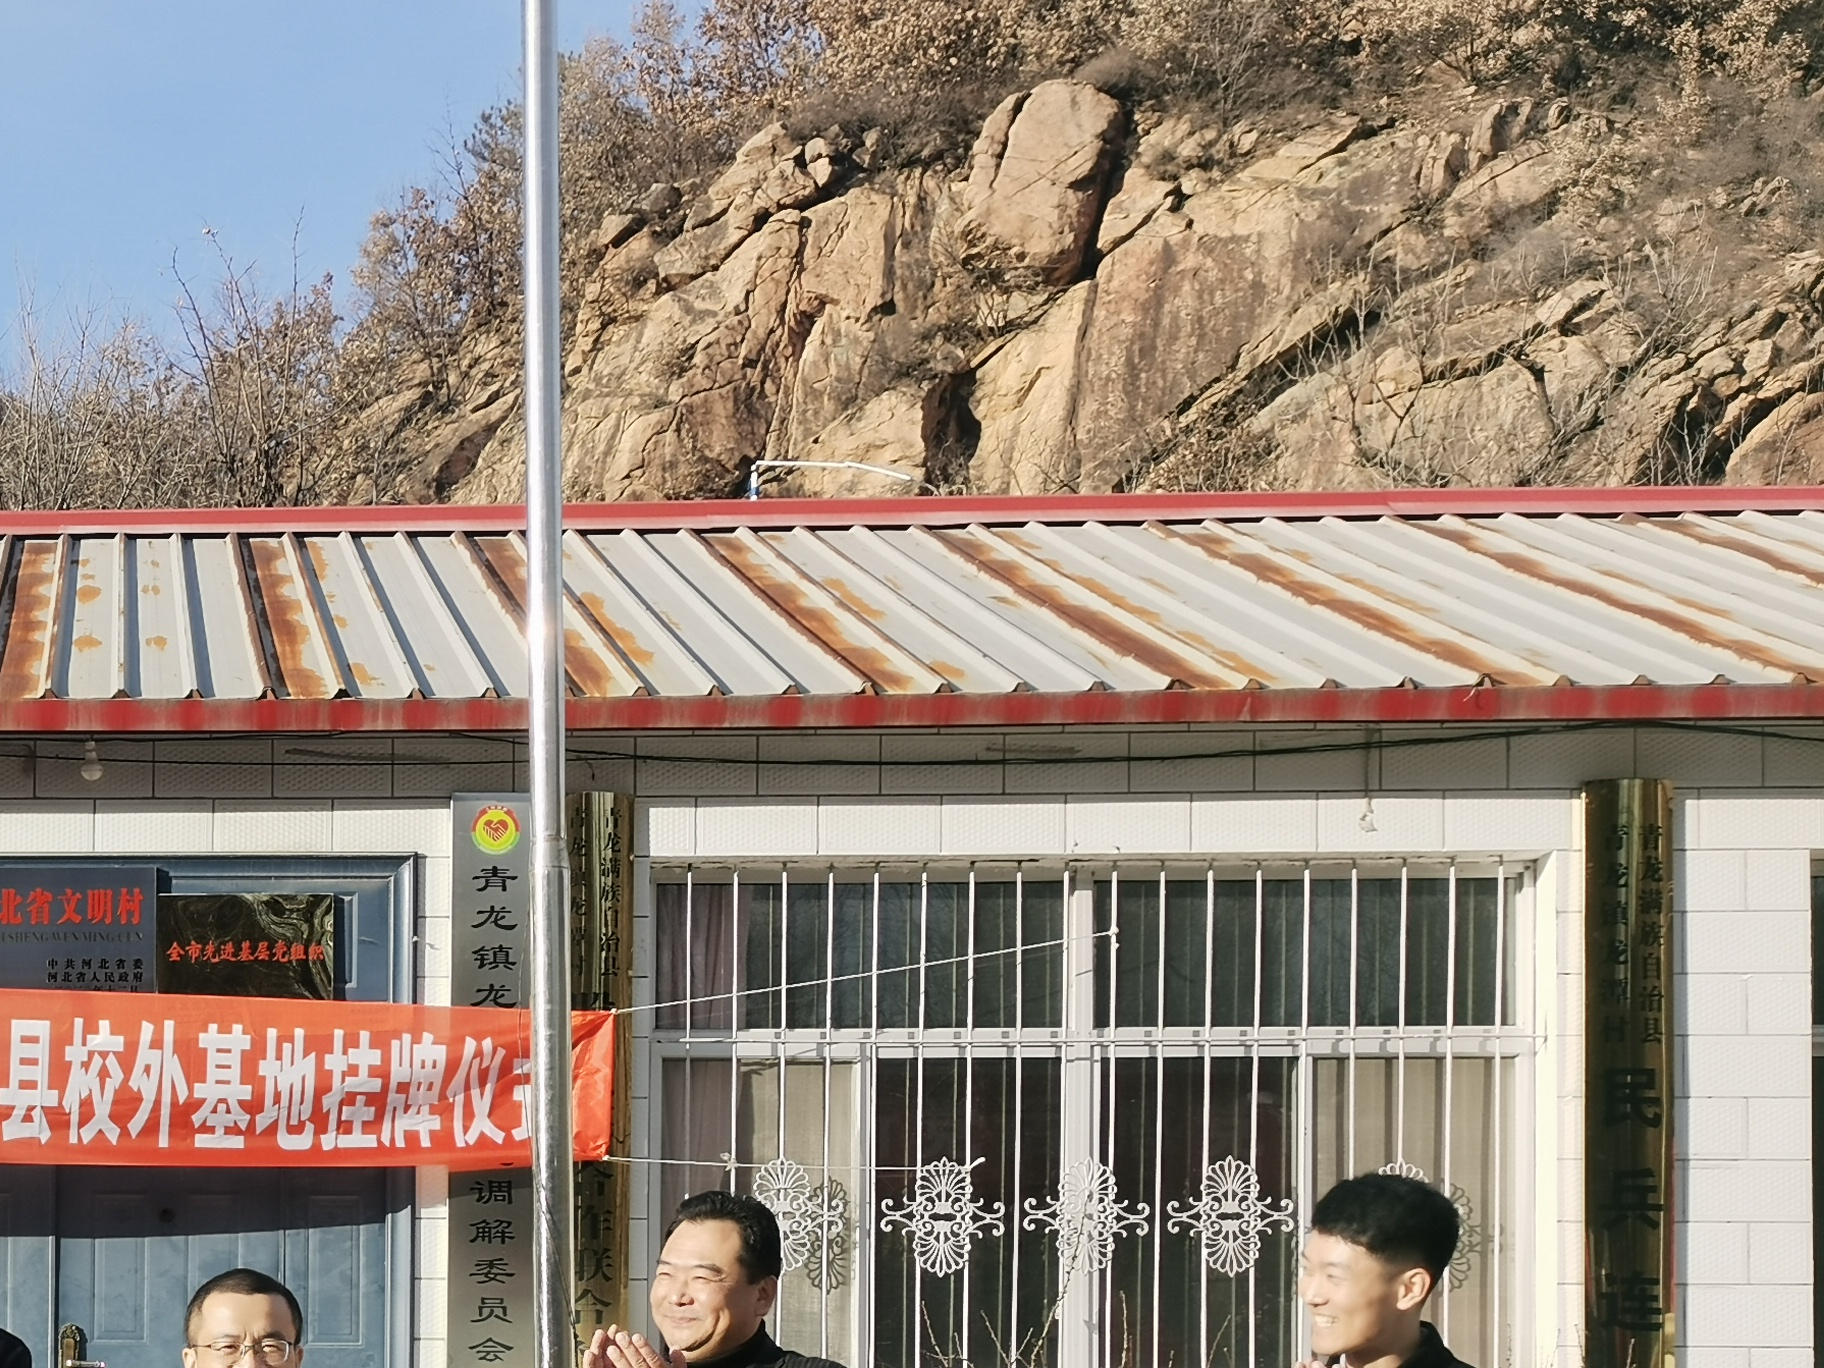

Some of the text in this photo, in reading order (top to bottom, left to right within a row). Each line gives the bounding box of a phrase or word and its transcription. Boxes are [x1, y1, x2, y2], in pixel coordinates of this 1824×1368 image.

[47, 958, 144, 970] 中共河北省委
[47, 971, 144, 983] 河北省人民政府
[166, 940, 325, 964] 全市先进基层党组织
[1638, 823, 1664, 1045] 青龙满族自治县
[1597, 1068, 1664, 1331] 民兵连
[468, 1179, 516, 1363] 调解委员会
